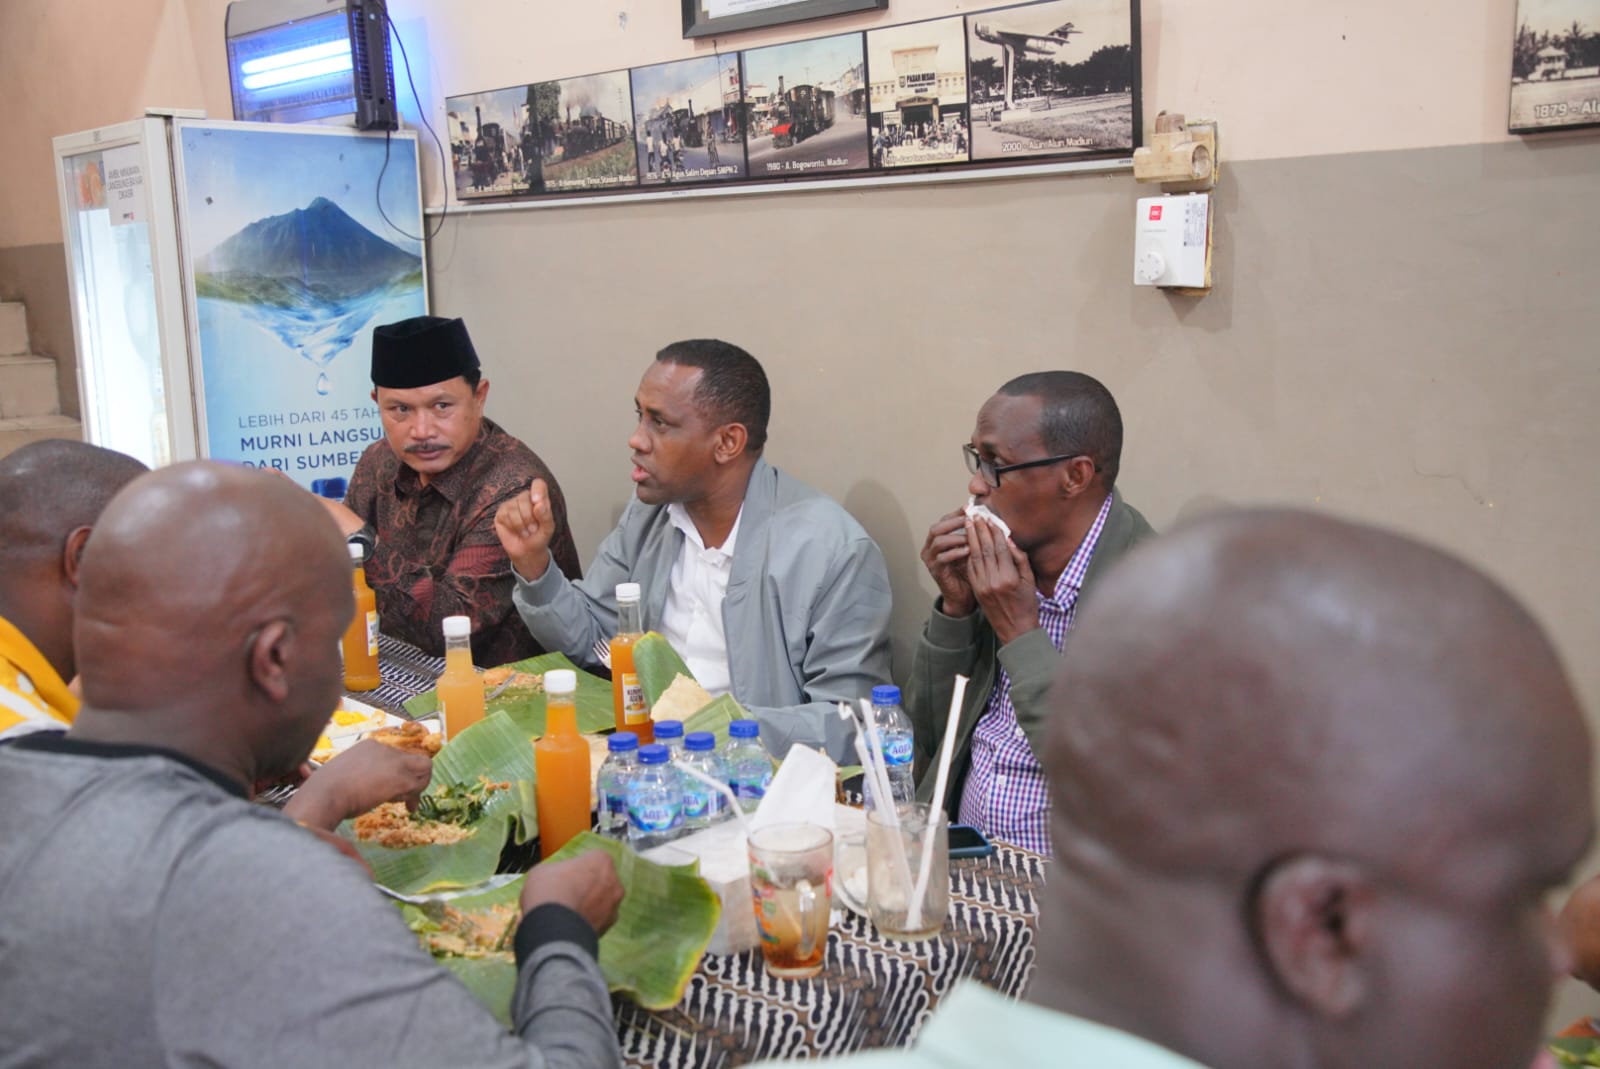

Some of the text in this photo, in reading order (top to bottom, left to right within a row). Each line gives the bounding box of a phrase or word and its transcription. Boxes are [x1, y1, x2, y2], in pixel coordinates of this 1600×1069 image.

[1535, 103, 1568, 119] 1879
[1002, 142, 1022, 152] 2000
[1048, 138, 1065, 147] Alun
[1066, 136, 1094, 147] Madiun
[827, 156, 849, 167] Madiun
[238, 414, 284, 429] LEBIH
[289, 411, 325, 425] DARI
[331, 408, 348, 421] 45
[240, 427, 385, 452] MURNI LANGSU
